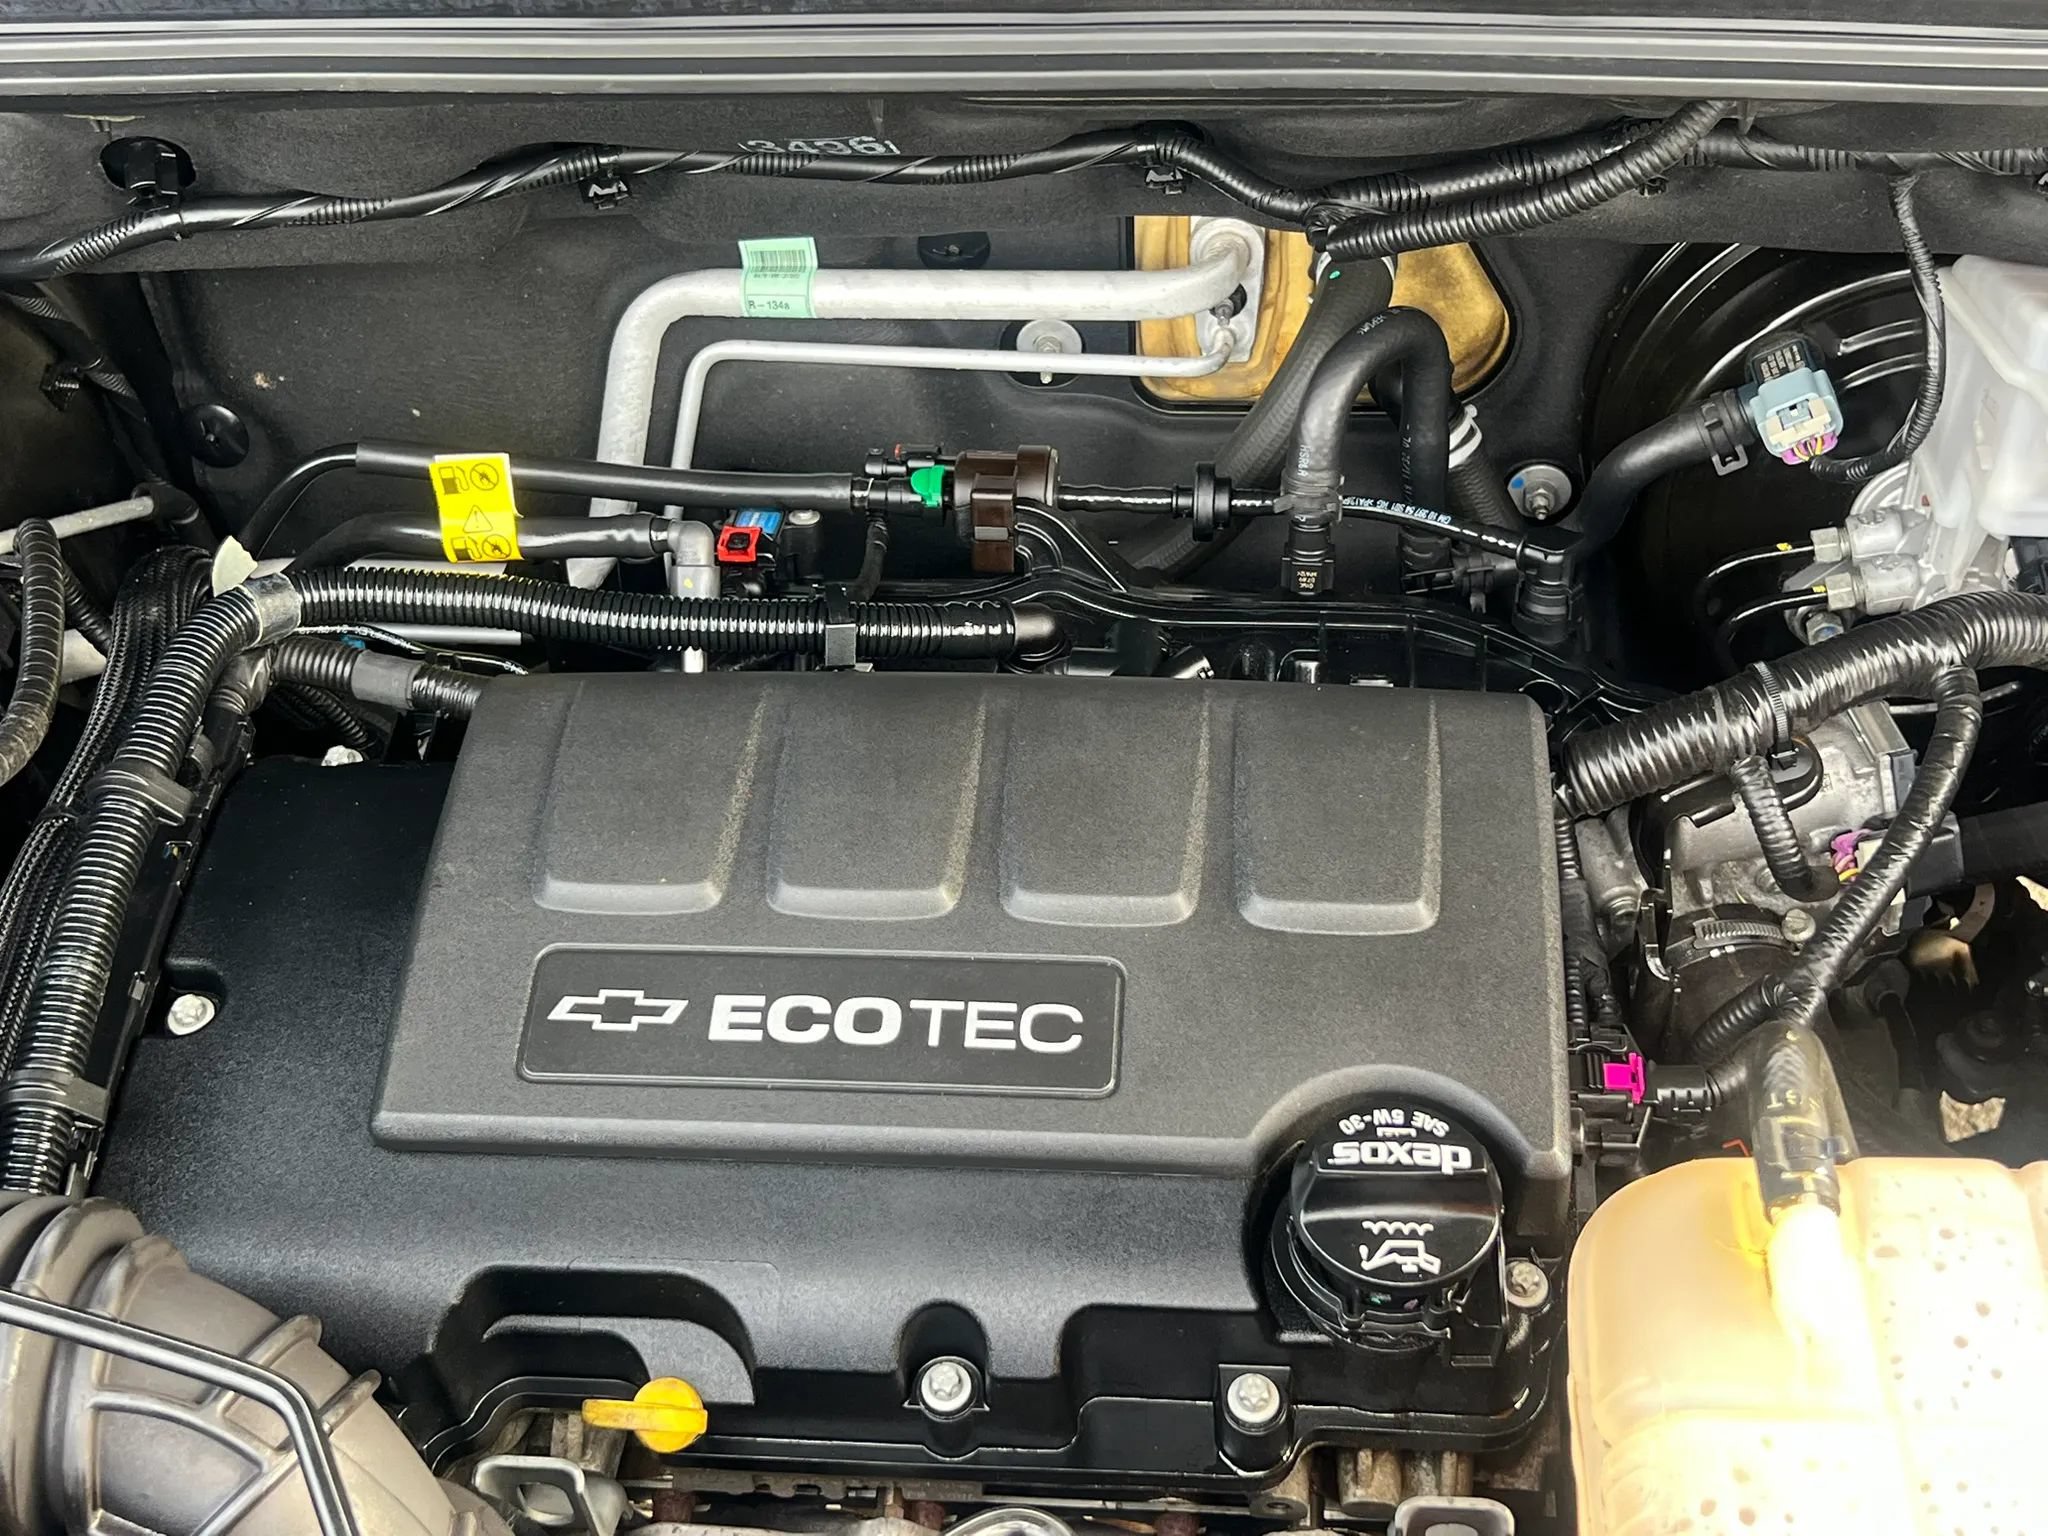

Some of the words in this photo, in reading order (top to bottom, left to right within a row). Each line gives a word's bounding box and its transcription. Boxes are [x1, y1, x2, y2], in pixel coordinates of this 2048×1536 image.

[707, 993, 1085, 1054] ECOTEC
[1338, 1108, 1405, 1136] 5W-30
[1410, 1110, 1450, 1138] SAE
[1332, 1141, 1472, 1175] dexos
